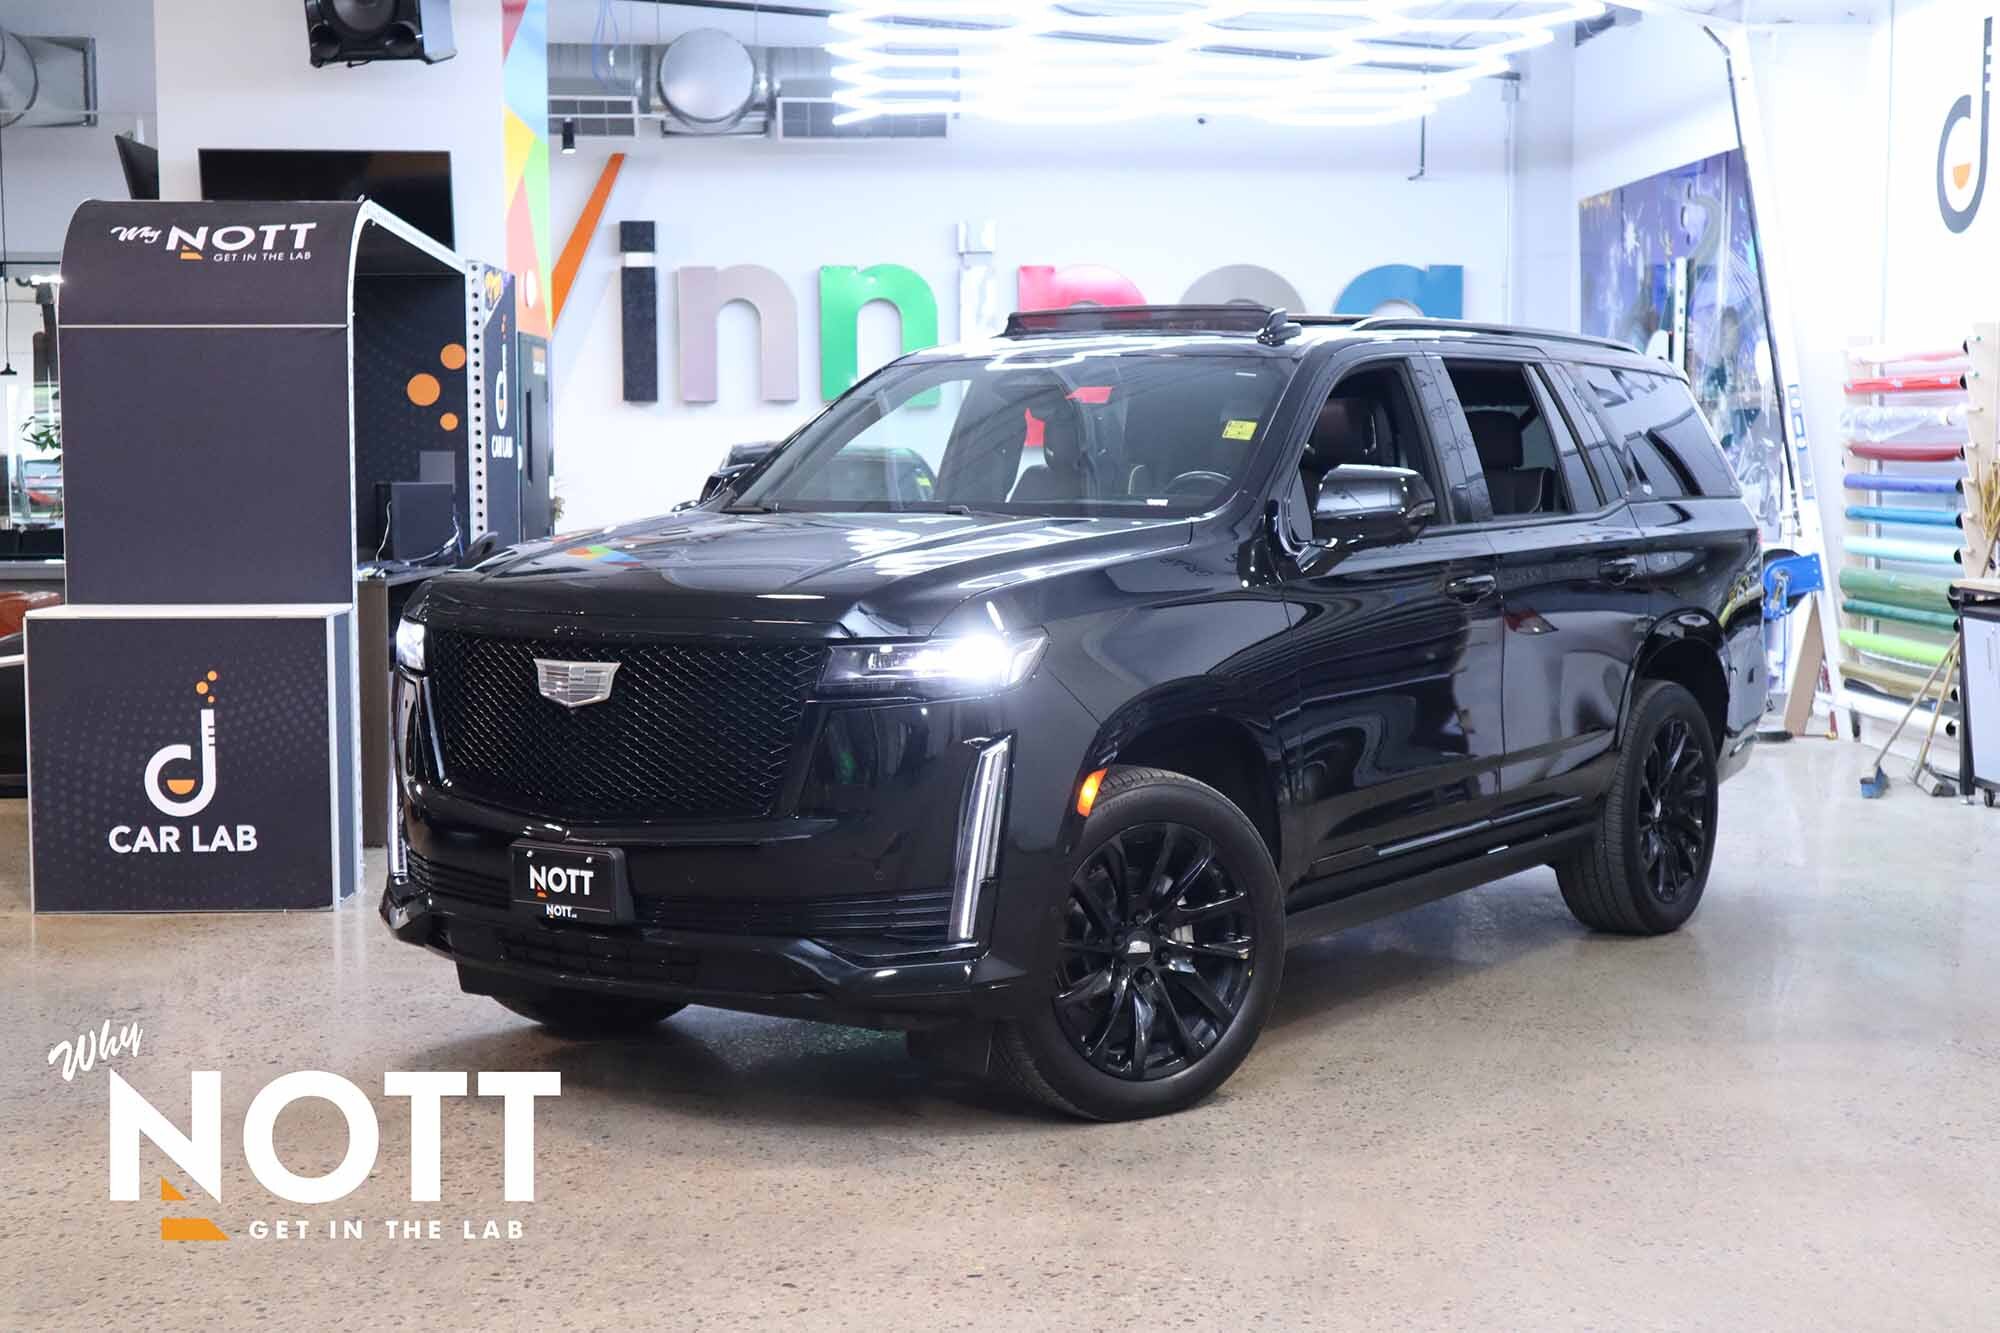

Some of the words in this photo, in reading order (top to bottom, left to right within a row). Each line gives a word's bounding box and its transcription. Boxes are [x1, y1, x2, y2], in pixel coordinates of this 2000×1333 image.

[110, 225, 162, 244] Why
[165, 222, 317, 251] NOTT
[213, 252, 238, 262] GET
[243, 253, 257, 262] IN
[262, 252, 284, 261] THE
[290, 251, 311, 261] LAB
[108, 825, 181, 853] CAR
[192, 824, 258, 852] LAB
[529, 864, 594, 895] NOTT
